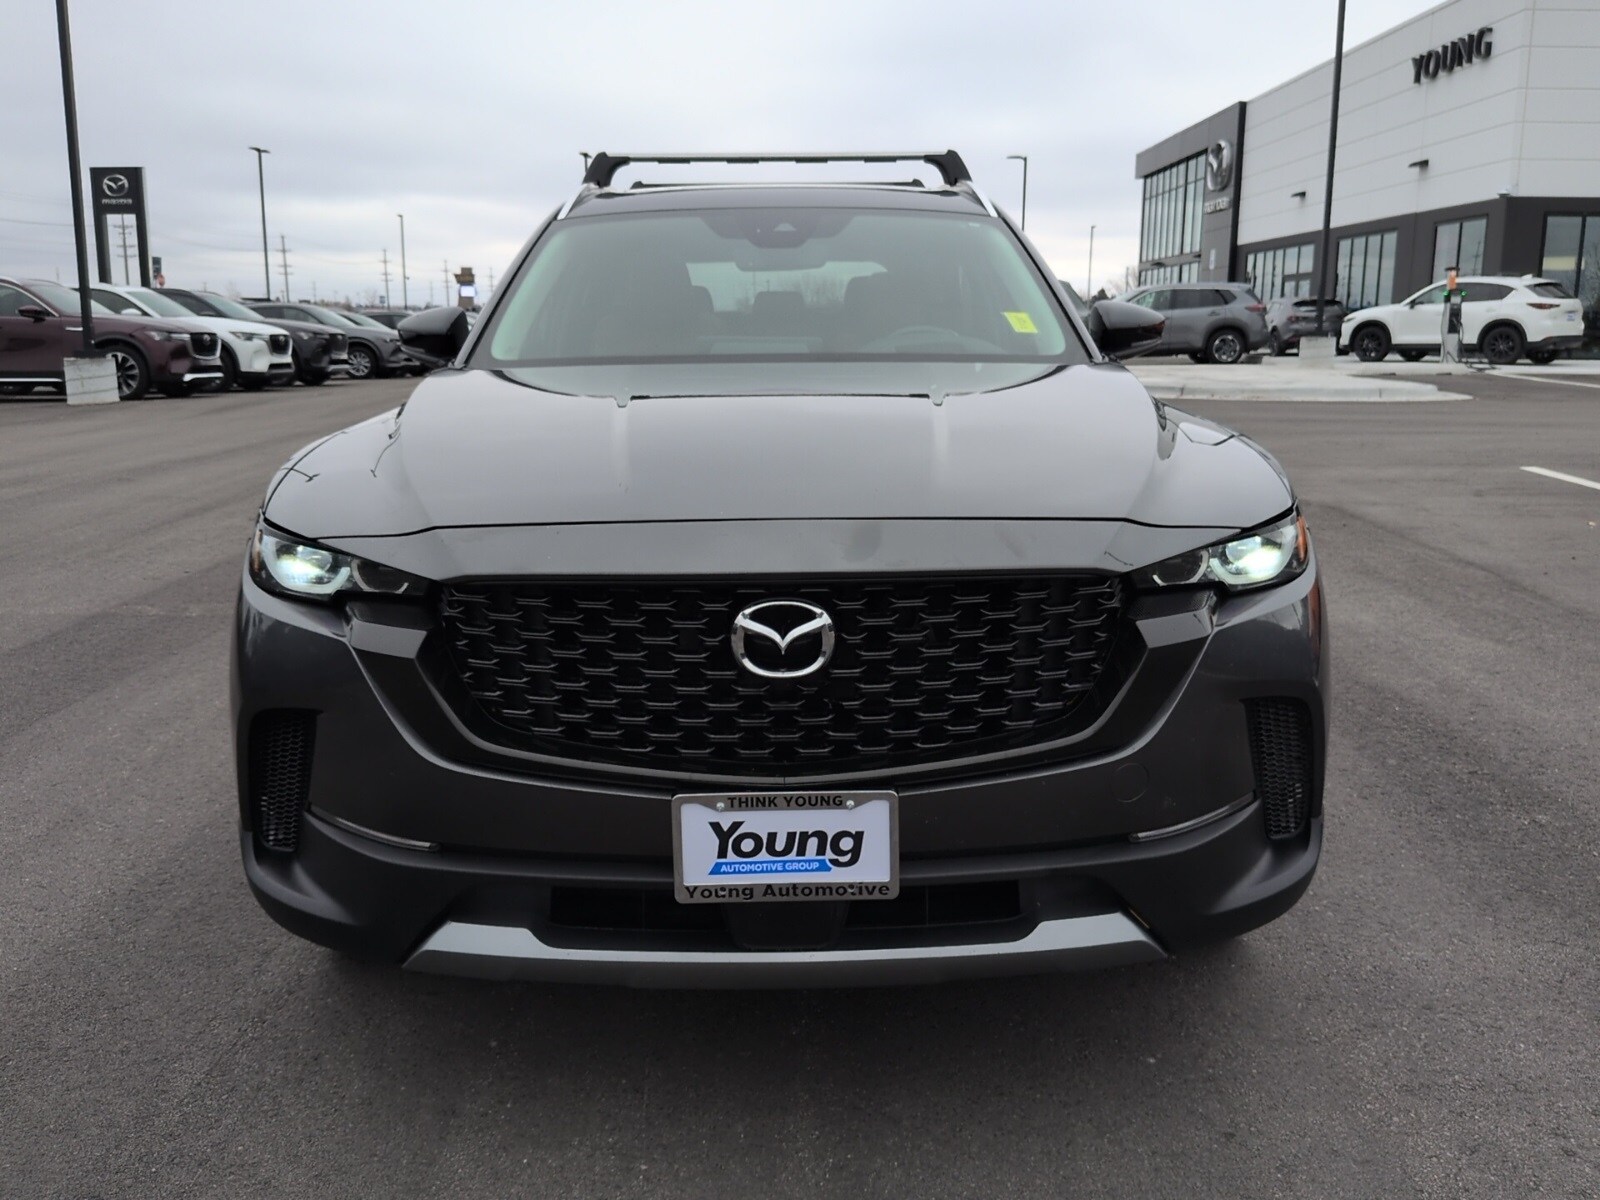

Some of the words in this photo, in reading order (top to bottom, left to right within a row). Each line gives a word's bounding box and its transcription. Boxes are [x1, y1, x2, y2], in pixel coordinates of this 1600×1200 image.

[1411, 26, 1493, 85] YOUNG
[727, 797, 778, 808] THINK
[783, 795, 843, 807] YOUNG
[708, 820, 864, 868] Young
[720, 862, 782, 873] AUTOMOTIVE
[785, 862, 820, 871] GROUP
[685, 886, 754, 900] Young
[762, 883, 890, 898] Automotive
